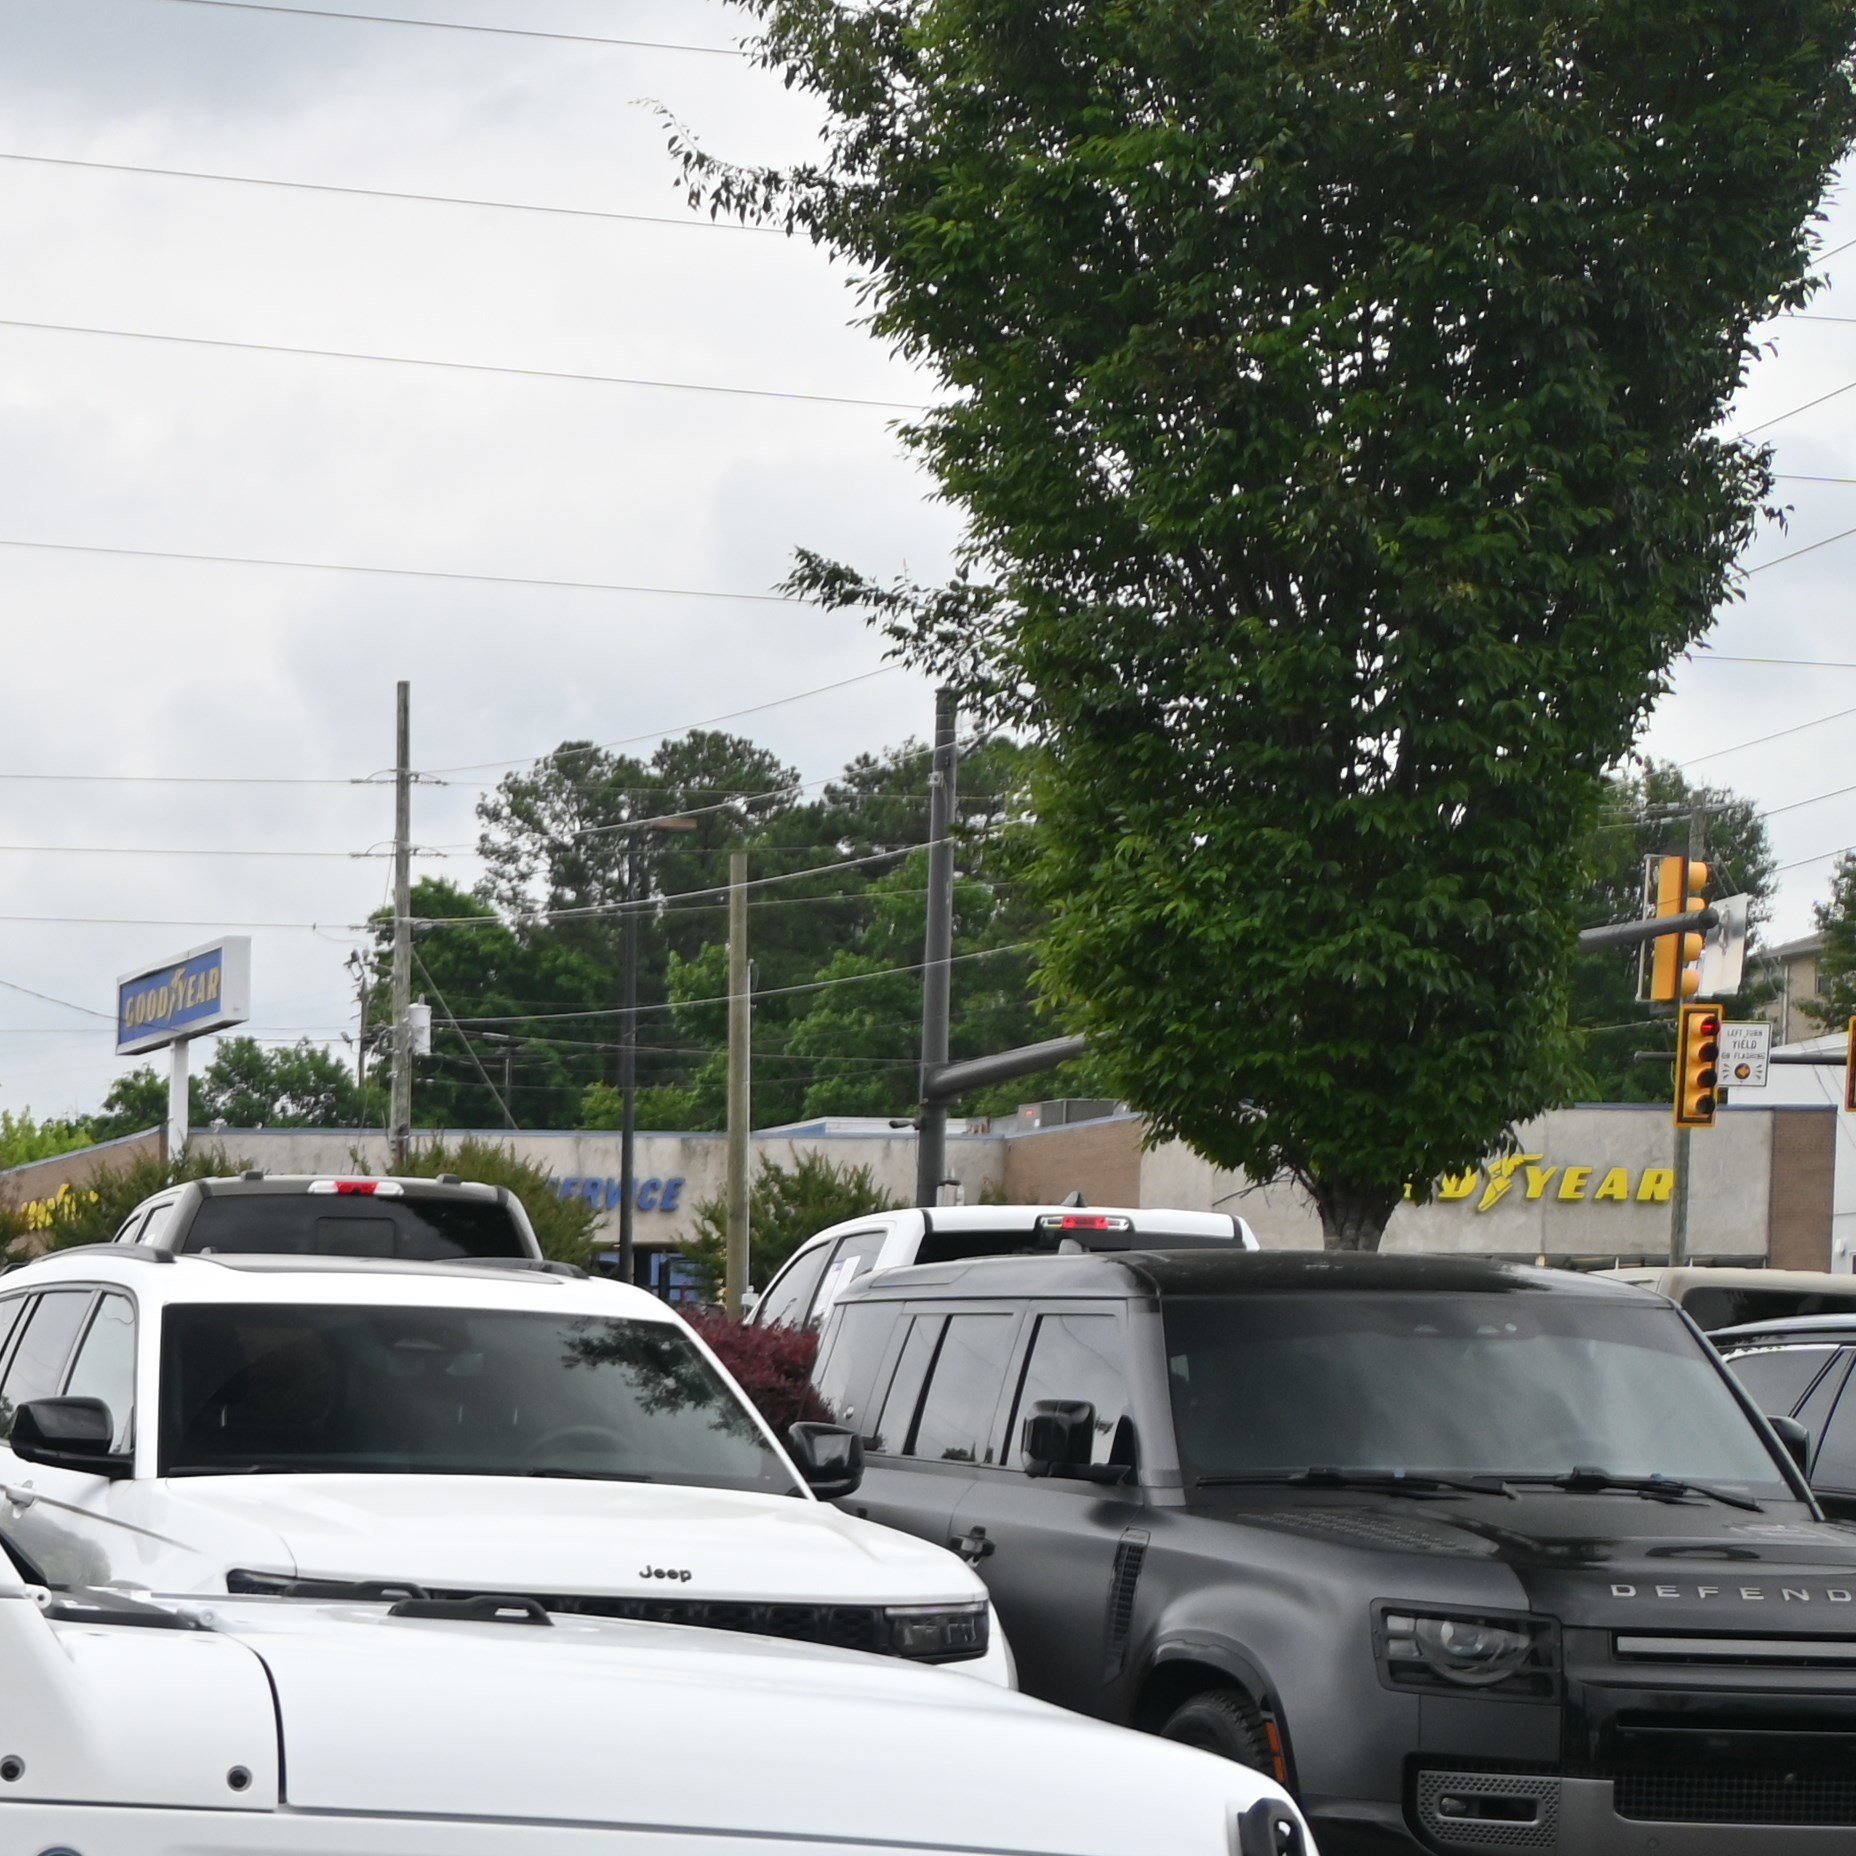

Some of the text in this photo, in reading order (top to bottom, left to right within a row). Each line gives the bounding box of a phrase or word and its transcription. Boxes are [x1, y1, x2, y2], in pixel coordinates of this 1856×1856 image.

[125, 967, 221, 1028] GOODYEAR
[1732, 1040, 1757, 1049] YIELD
[639, 1564, 692, 1583] Jeep
[1610, 1584, 1853, 1602] DEFEND
